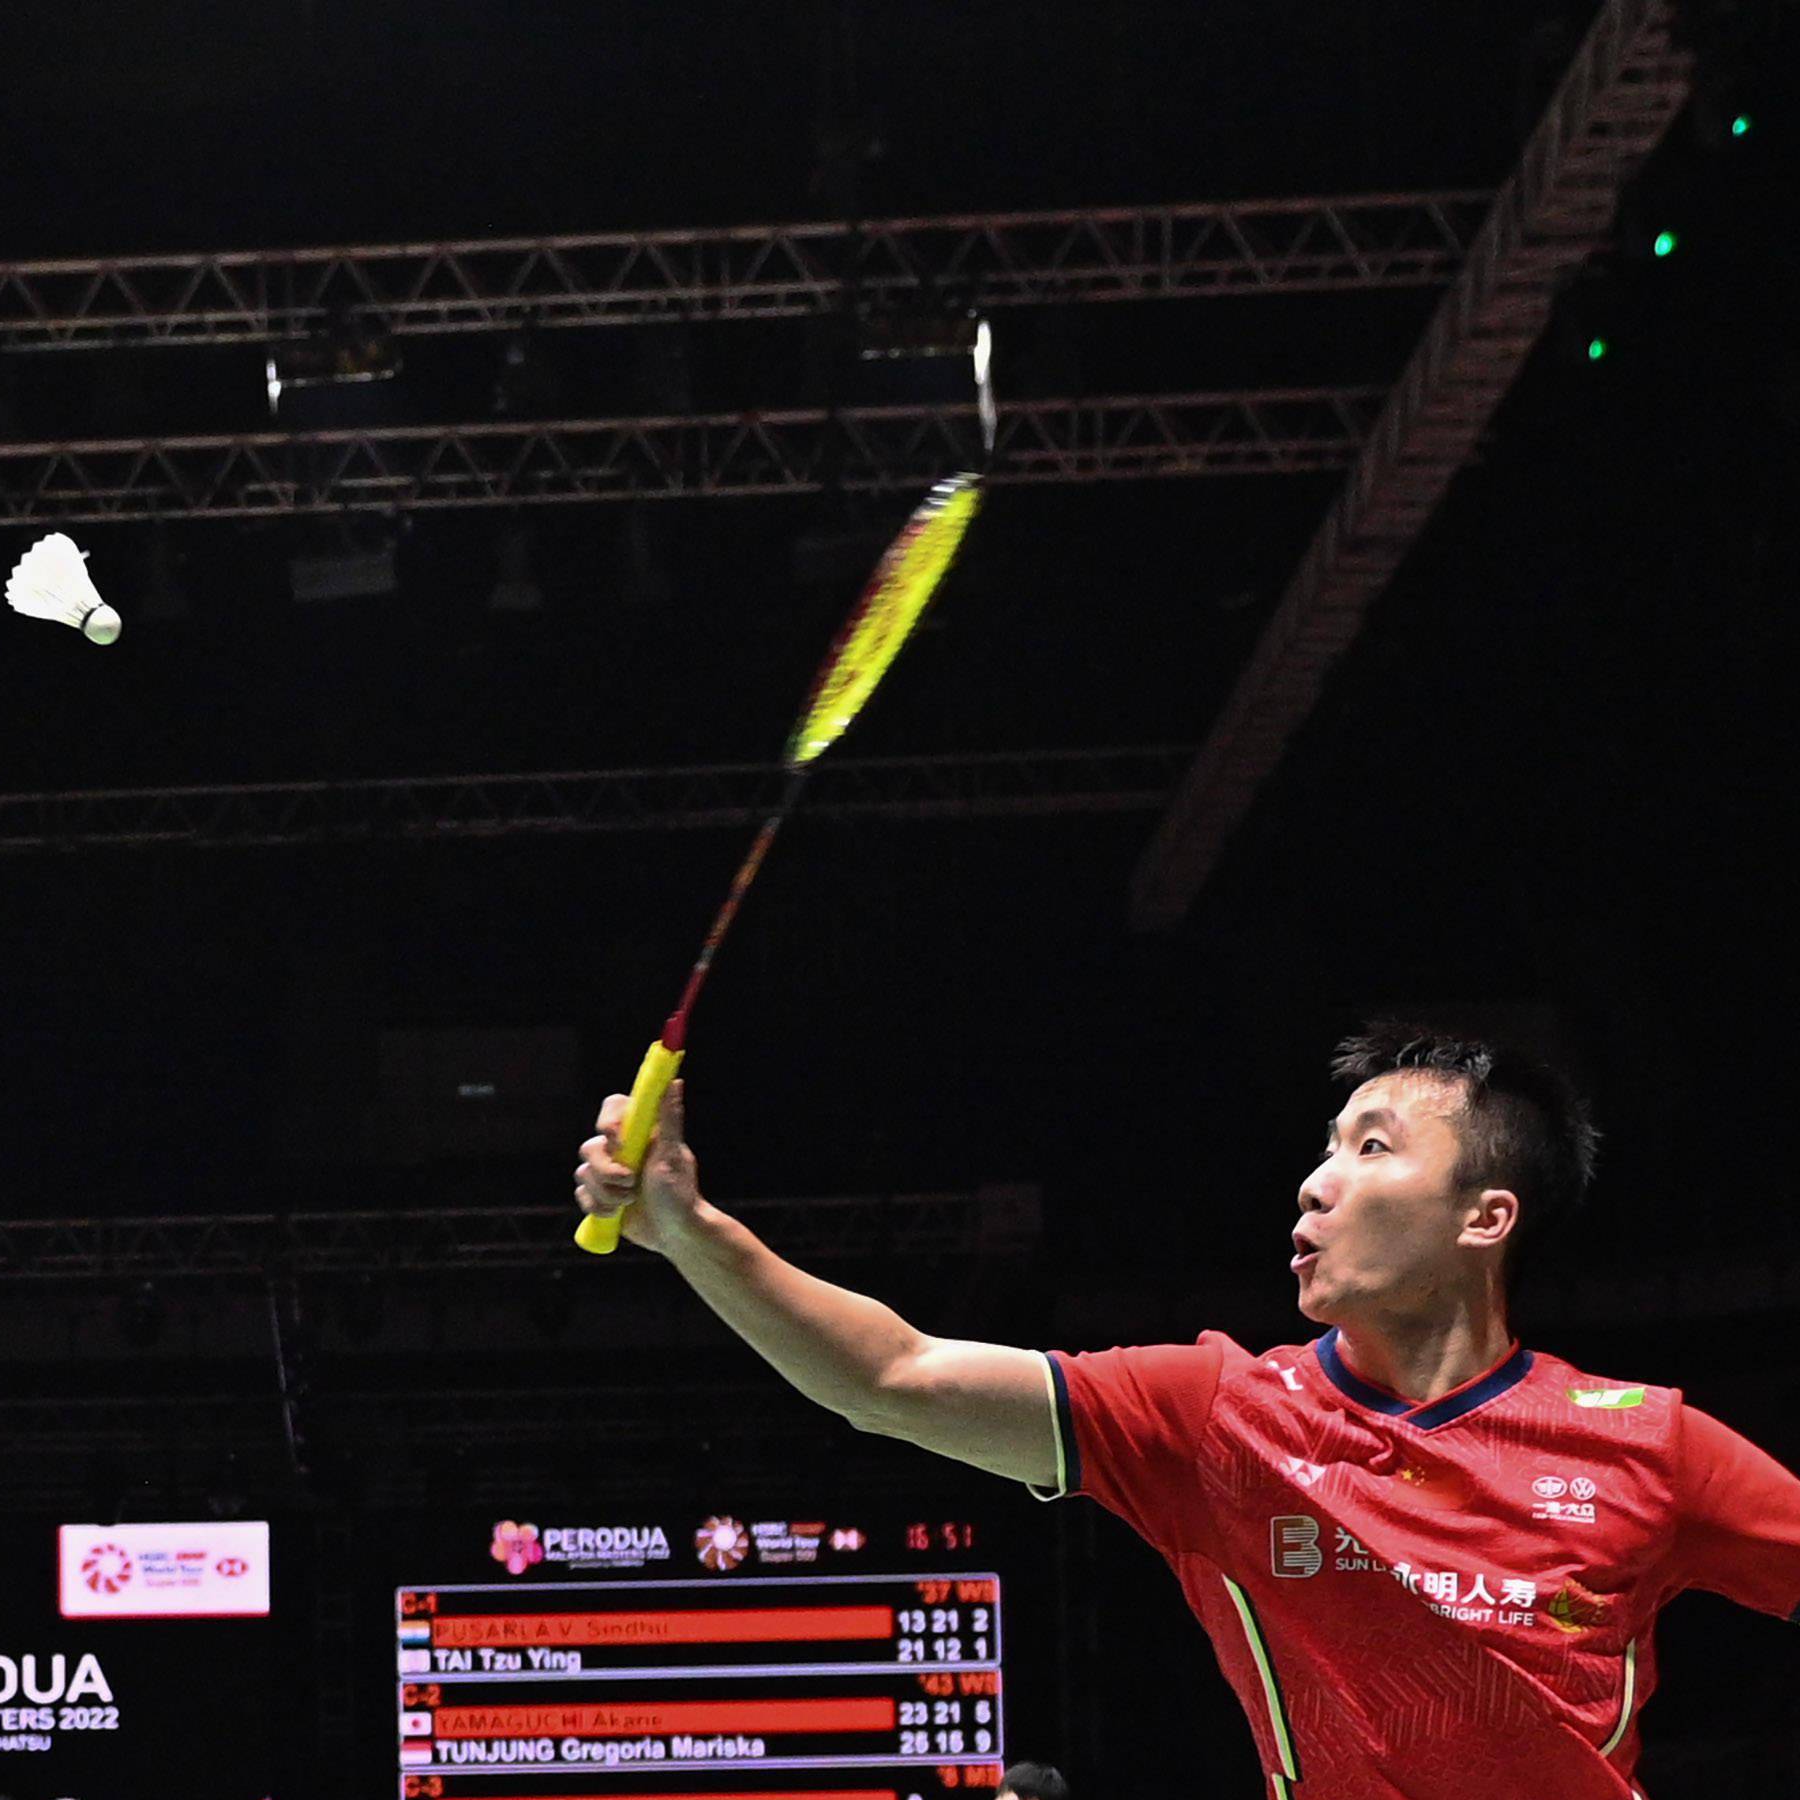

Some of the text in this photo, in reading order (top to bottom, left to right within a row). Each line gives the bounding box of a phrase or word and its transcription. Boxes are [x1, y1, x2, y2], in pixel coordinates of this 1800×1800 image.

[543, 1526, 670, 1551] PERODUA
[1335, 1557, 1369, 1571] SUN
[898, 1608, 989, 1633] 13 21 2
[1498, 1610, 1535, 1627] LIFE
[434, 1647, 581, 1672] TAI Tzu Ying
[898, 1636, 988, 1662] 21 12 1
[58, 1706, 119, 1730] 2022
[899, 1701, 928, 1725] 23
[933, 1701, 961, 1725] 21
[436, 1735, 766, 1765] TUNJUNG Gregoria Mariska
[975, 1729, 991, 1753] 9
